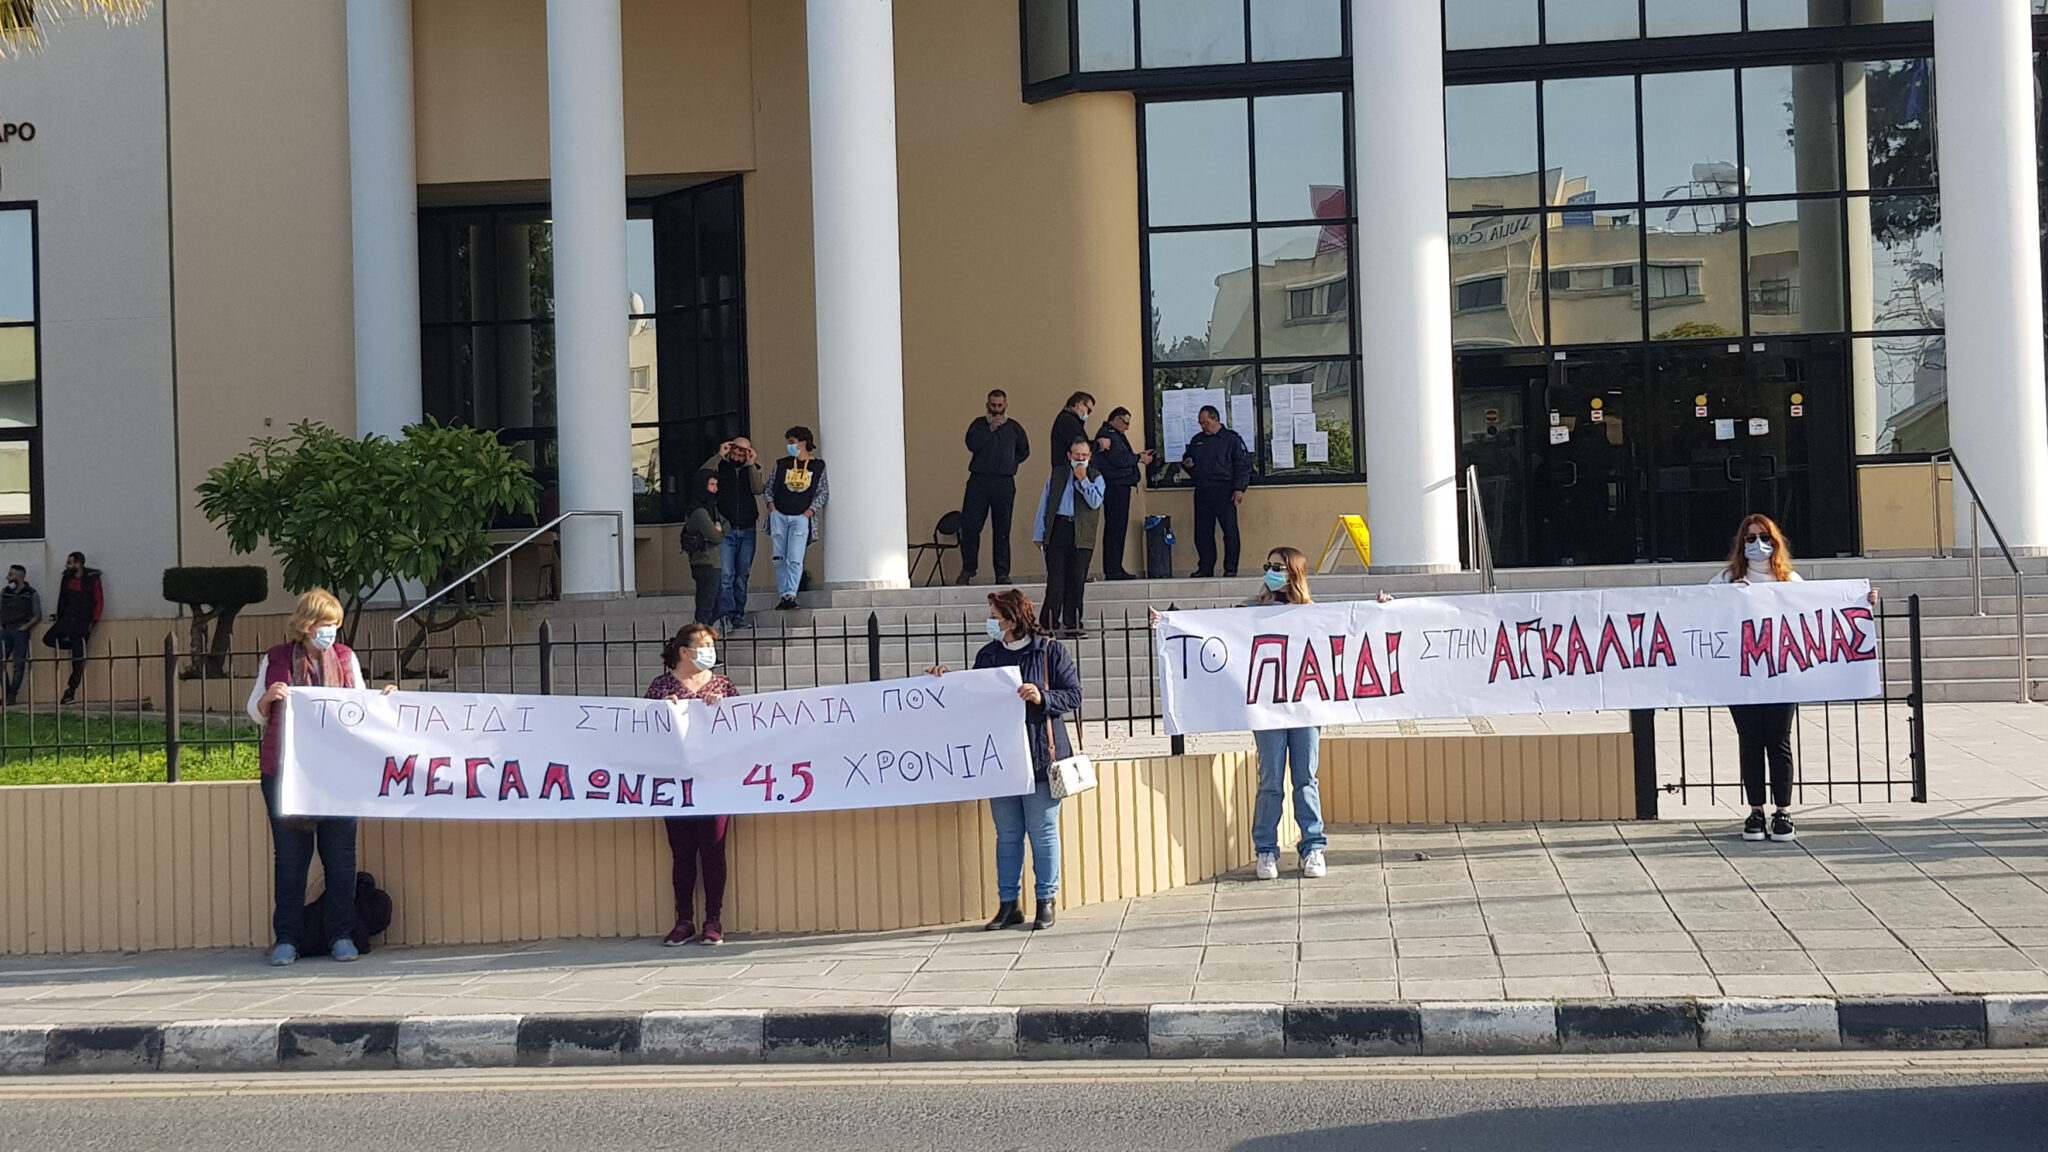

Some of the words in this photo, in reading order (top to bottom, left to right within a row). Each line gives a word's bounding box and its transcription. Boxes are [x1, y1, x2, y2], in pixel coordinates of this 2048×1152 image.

[0, 122, 36, 142] ΡΟ
[1165, 634, 1228, 680] ΤΟ
[1246, 631, 1405, 704] ΠΑΙΔΙ
[1419, 627, 1487, 660] ΣΤΗΝ
[1488, 611, 1677, 684] ΑΓΚΑΛΙΑ
[1682, 628, 1732, 660] ΤΗΣ
[1740, 607, 1877, 678] ΜΑΝΑΣ
[310, 698, 366, 729] ΤΟ
[397, 704, 536, 733] ΠΑΙΔΙ
[575, 705, 672, 733] ΣΤΗΝ
[711, 697, 856, 734] ΑΓΚΑΛΙΑ
[882, 685, 946, 714] ΠΟΥ
[377, 753, 696, 808] ΜΕΓΑΛΩΝΕΙ
[742, 760, 815, 804] 4.5
[843, 733, 1005, 789] ΧΡΟΝΙΑ
